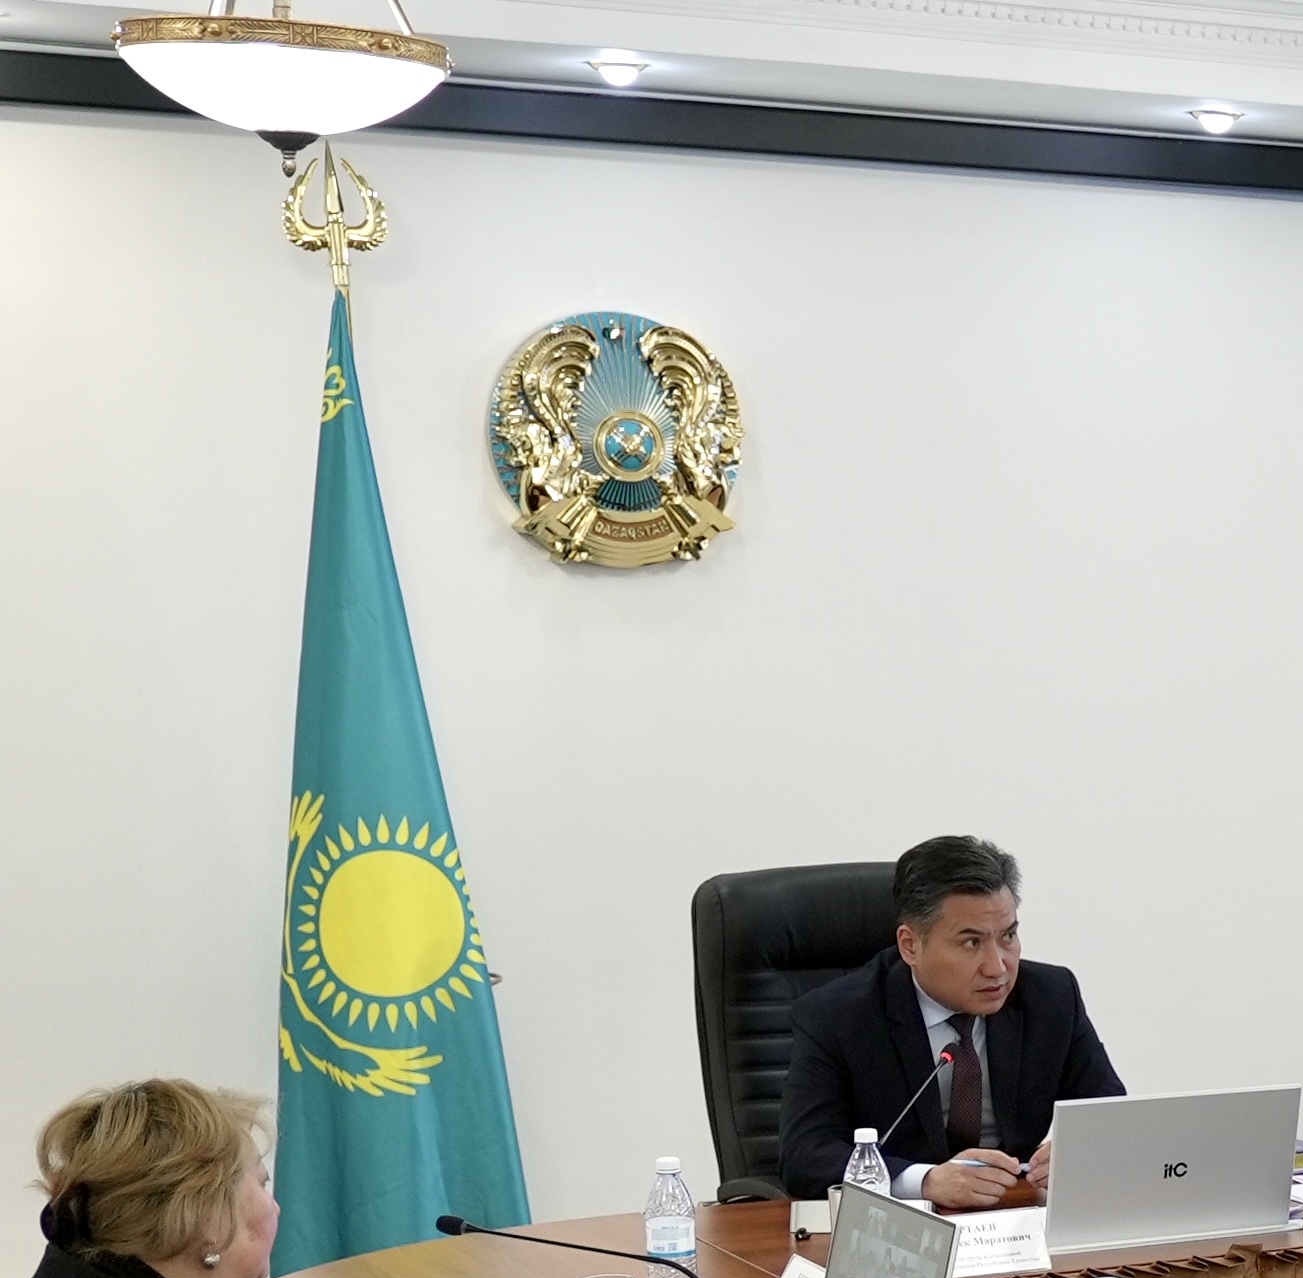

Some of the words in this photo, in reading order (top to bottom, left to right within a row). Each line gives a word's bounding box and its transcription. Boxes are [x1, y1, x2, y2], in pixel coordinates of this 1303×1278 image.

[594, 519, 670, 540] QAZAQSTAN
[959, 1223, 997, 1235] РТАЕВ
[973, 1233, 1031, 1247] Маратович
